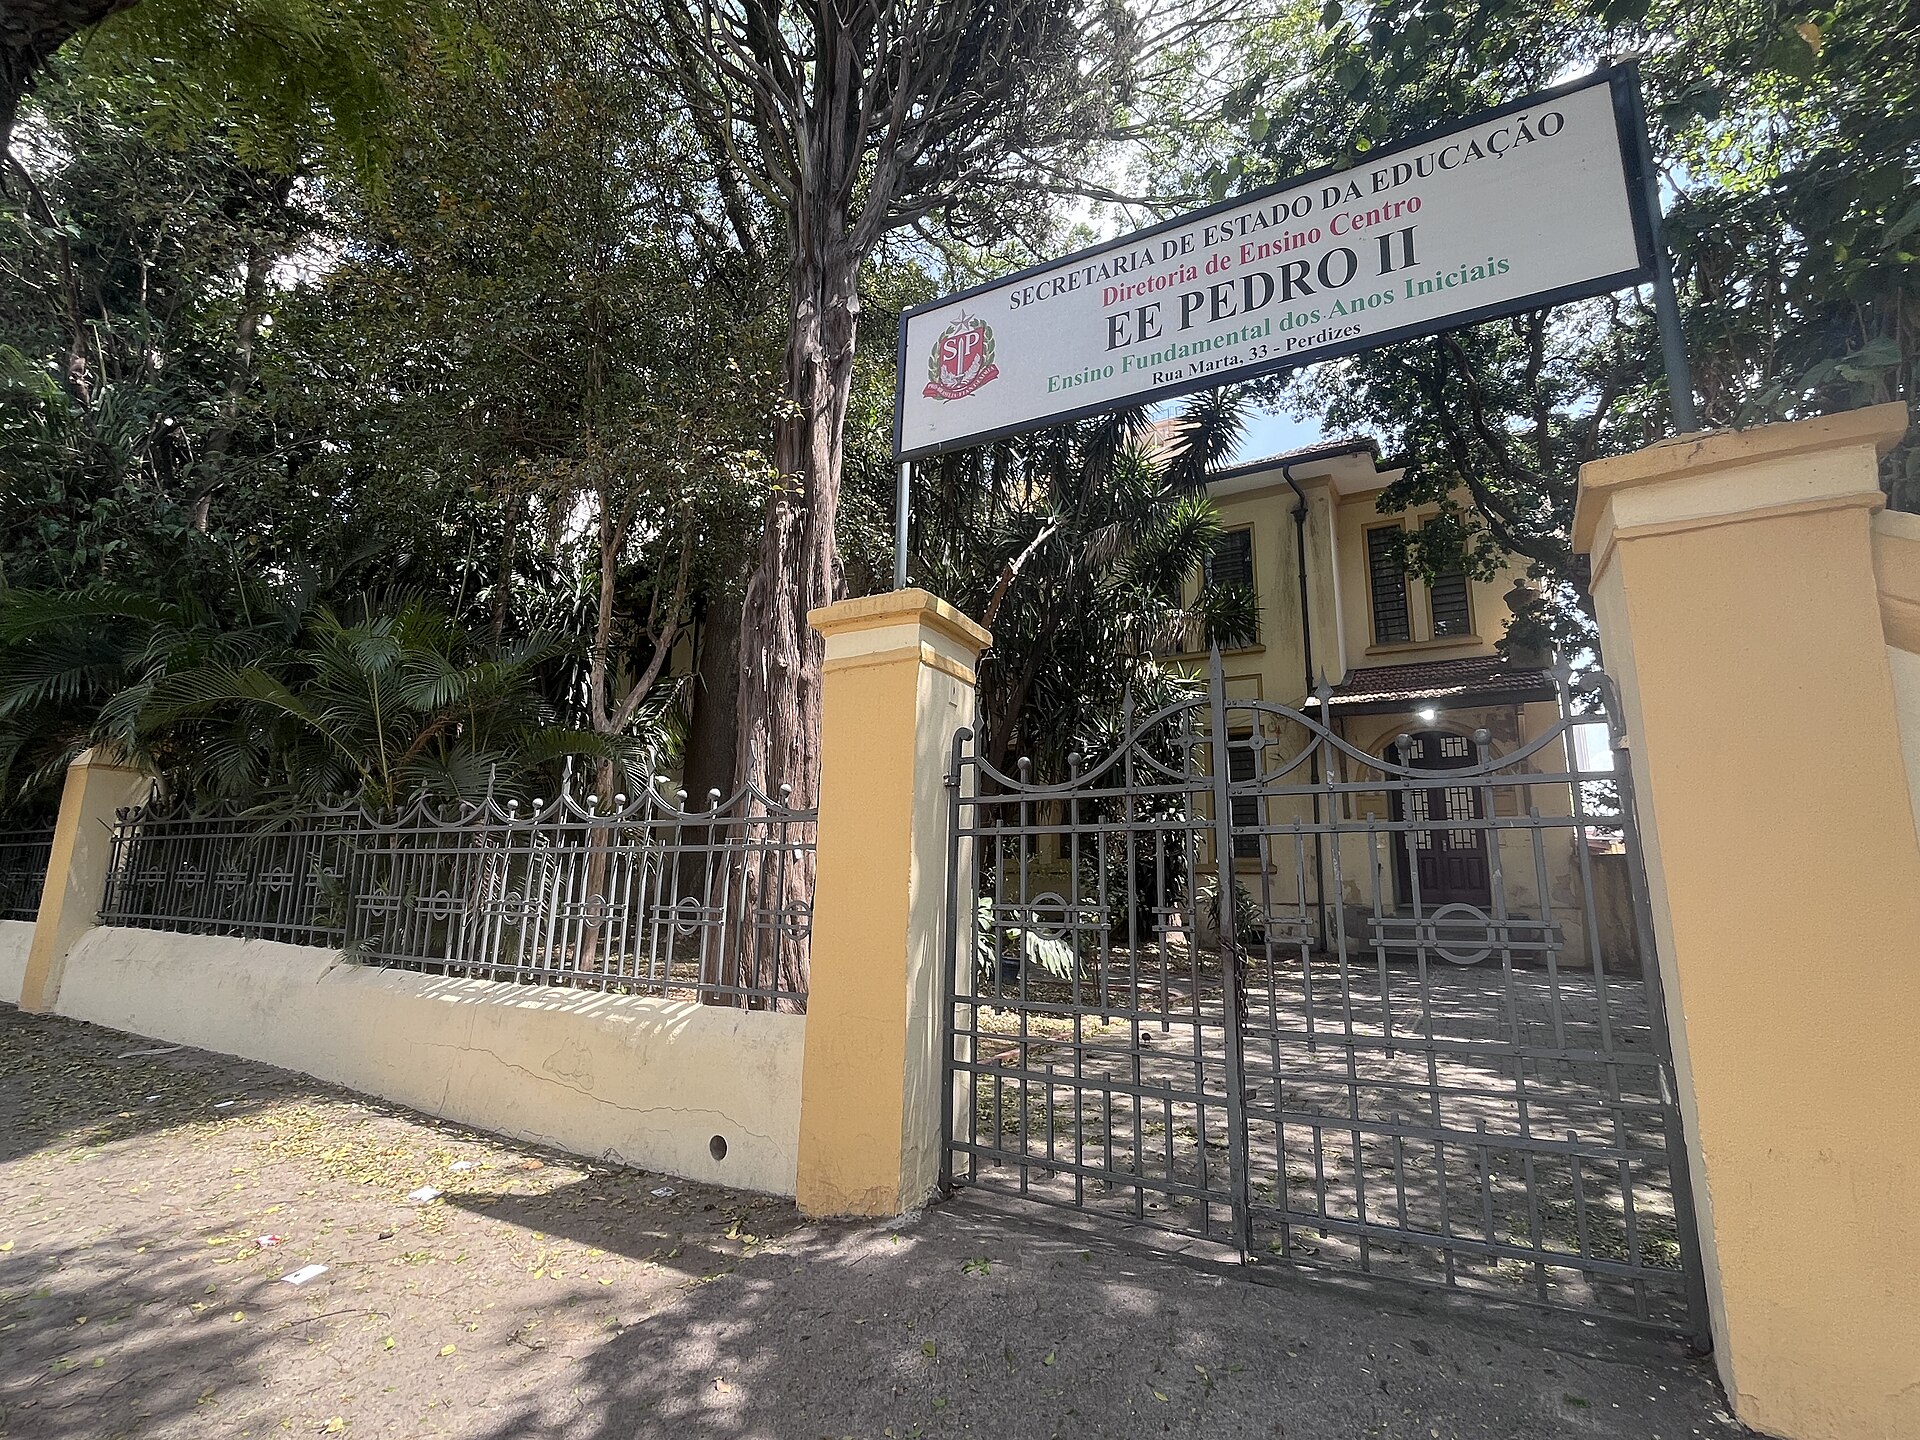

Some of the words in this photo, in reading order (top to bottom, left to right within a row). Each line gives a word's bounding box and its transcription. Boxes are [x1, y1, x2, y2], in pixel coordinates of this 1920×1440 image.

[1009, 248, 1156, 311] SECRETARIA
[1162, 233, 1196, 261] DE
[1203, 195, 1313, 248] ESTADO
[1321, 180, 1364, 210] DA
[1370, 112, 1565, 194] EDUCAÇÃO
[1102, 263, 1198, 308] Diretoria
[1205, 253, 1231, 275] de
[1239, 228, 1321, 266] Ensino
[1329, 196, 1422, 236] Centro
[1047, 365, 1114, 394] Ensino
[1121, 317, 1271, 374] Fundamental
[1279, 308, 1321, 332] dos
[1328, 288, 1395, 319] Anos
[1403, 256, 1510, 300] Iniciais
[1105, 302, 1163, 352] EE
[1177, 247, 1358, 332] PEDRO
[1374, 225, 1421, 277] II
[1152, 368, 1183, 386] Rua
[1188, 354, 1244, 381] Marta,
[1249, 344, 1268, 361] 33
[1286, 323, 1362, 352] Perdizes
